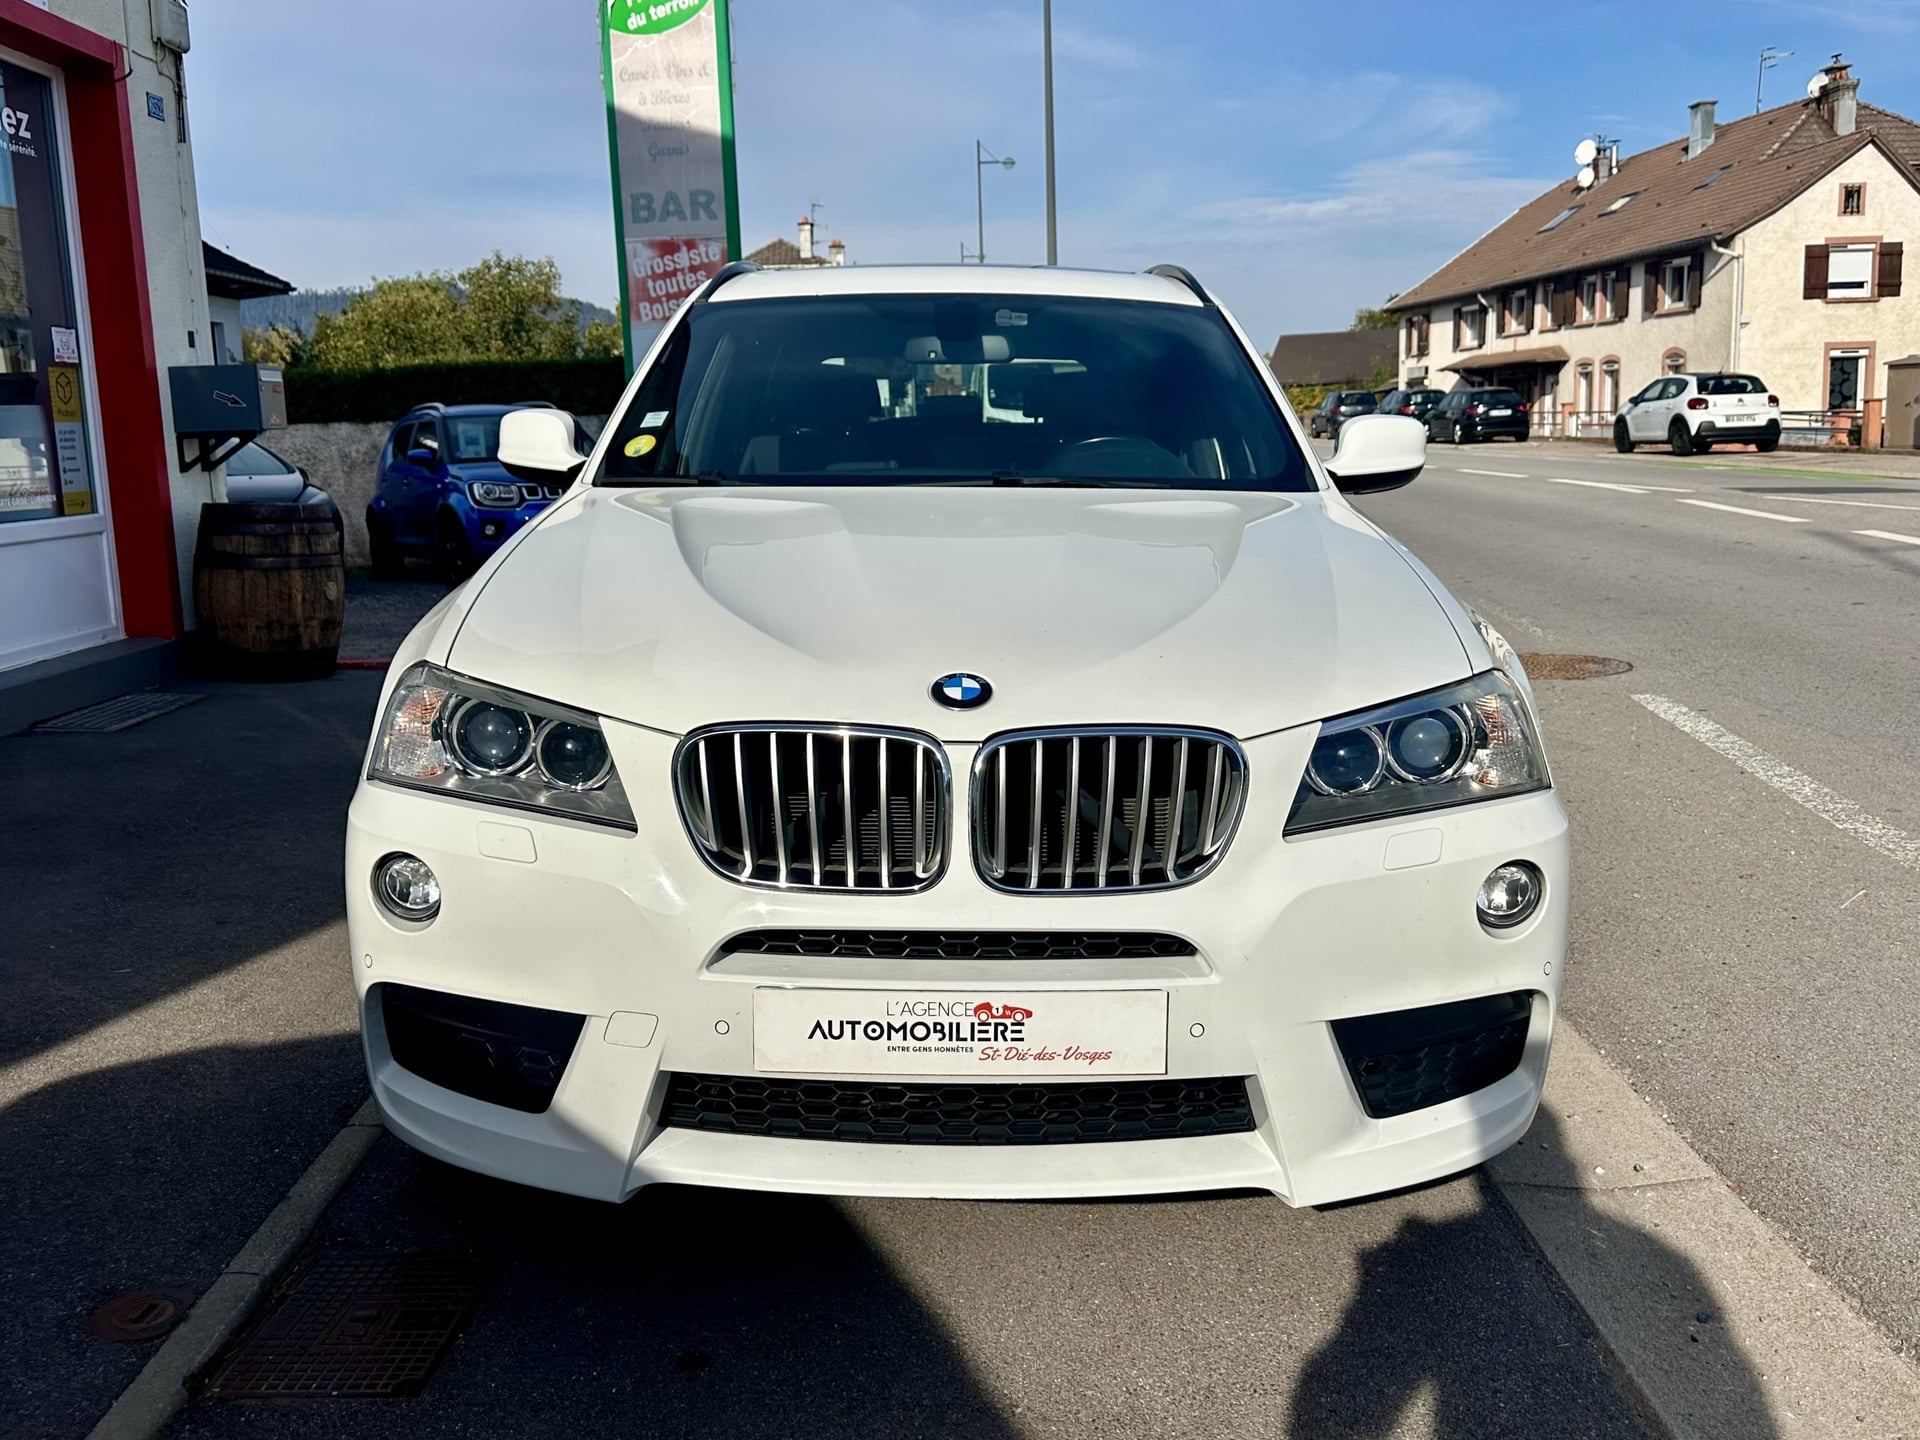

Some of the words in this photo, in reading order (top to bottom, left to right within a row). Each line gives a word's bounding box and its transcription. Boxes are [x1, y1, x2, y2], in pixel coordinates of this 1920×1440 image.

[627, 12, 647, 30] du
[0, 106, 31, 139] ez
[648, 142, 690, 161] Garnis
[630, 188, 719, 225] BAR
[633, 243, 721, 278] Grossiste
[646, 270, 707, 298] toutes
[886, 1001, 974, 1017] L'AGENCE
[995, 1007, 1000, 1015] 1
[934, 1044, 974, 1053] HONNÊTES
